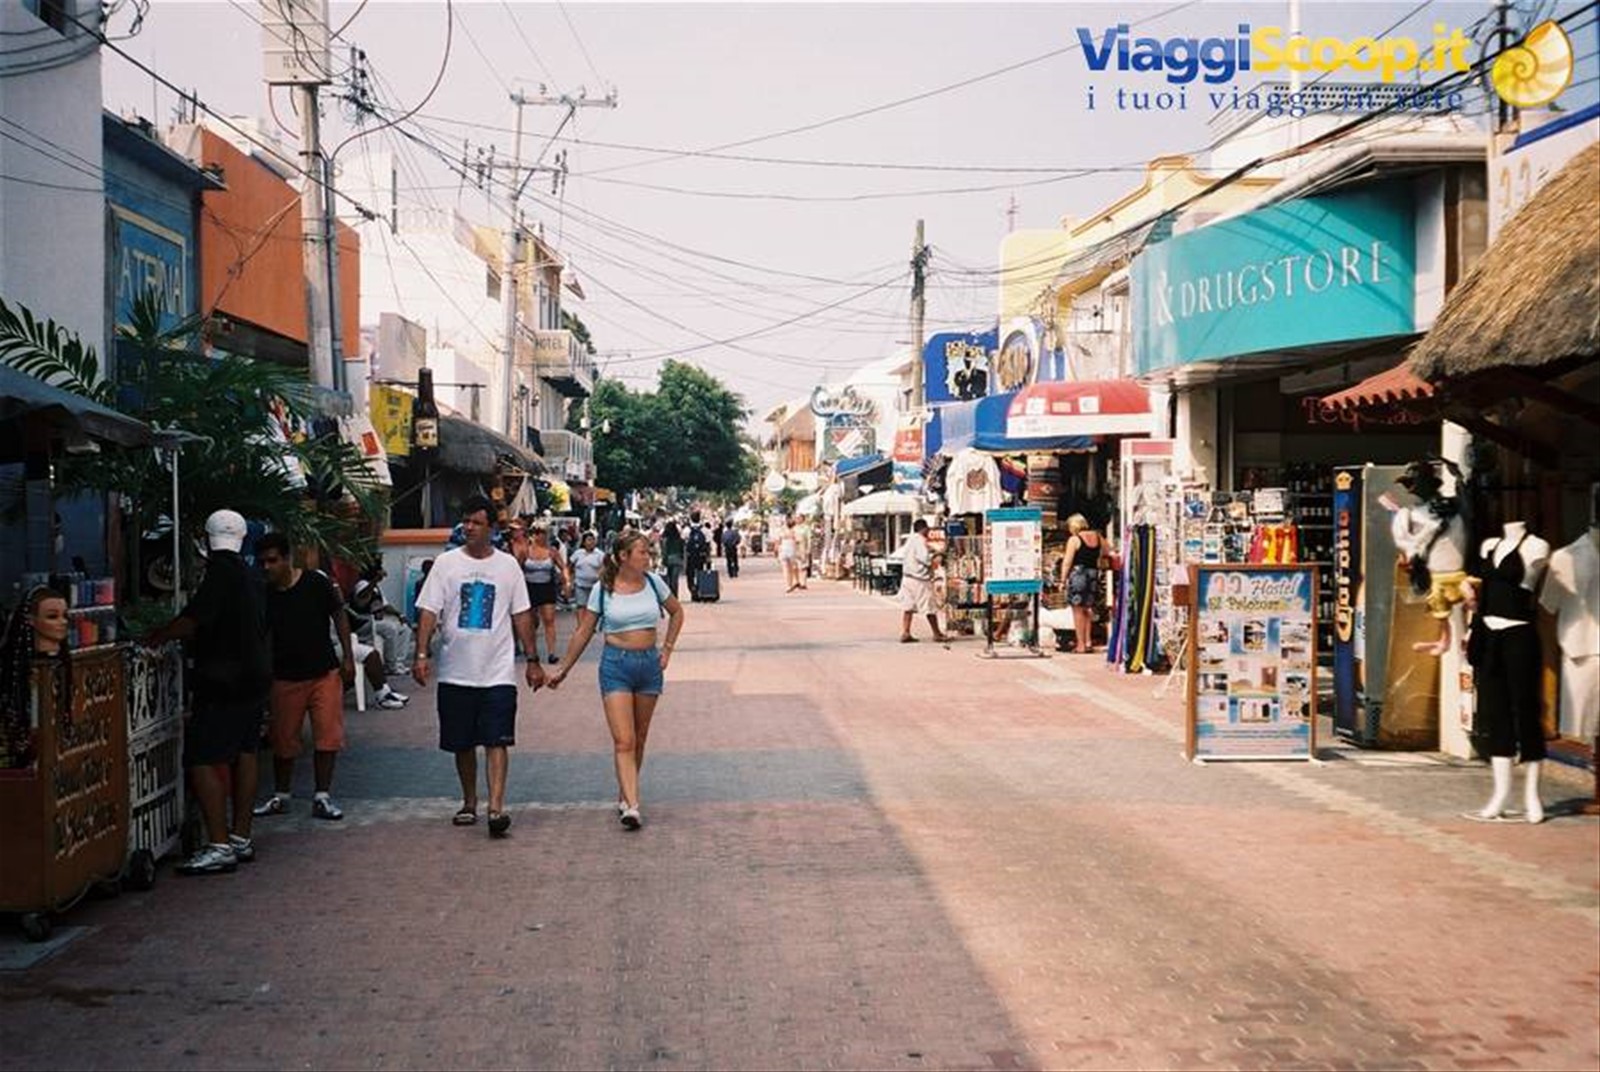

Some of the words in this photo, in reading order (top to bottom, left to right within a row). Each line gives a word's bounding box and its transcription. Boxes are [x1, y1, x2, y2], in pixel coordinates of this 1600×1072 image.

[1155, 269, 1175, 326] &
[1181, 241, 1393, 318] DRUGSTORE
[1301, 396, 1423, 432] Teqas
[1250, 574, 1303, 596] Hostel
